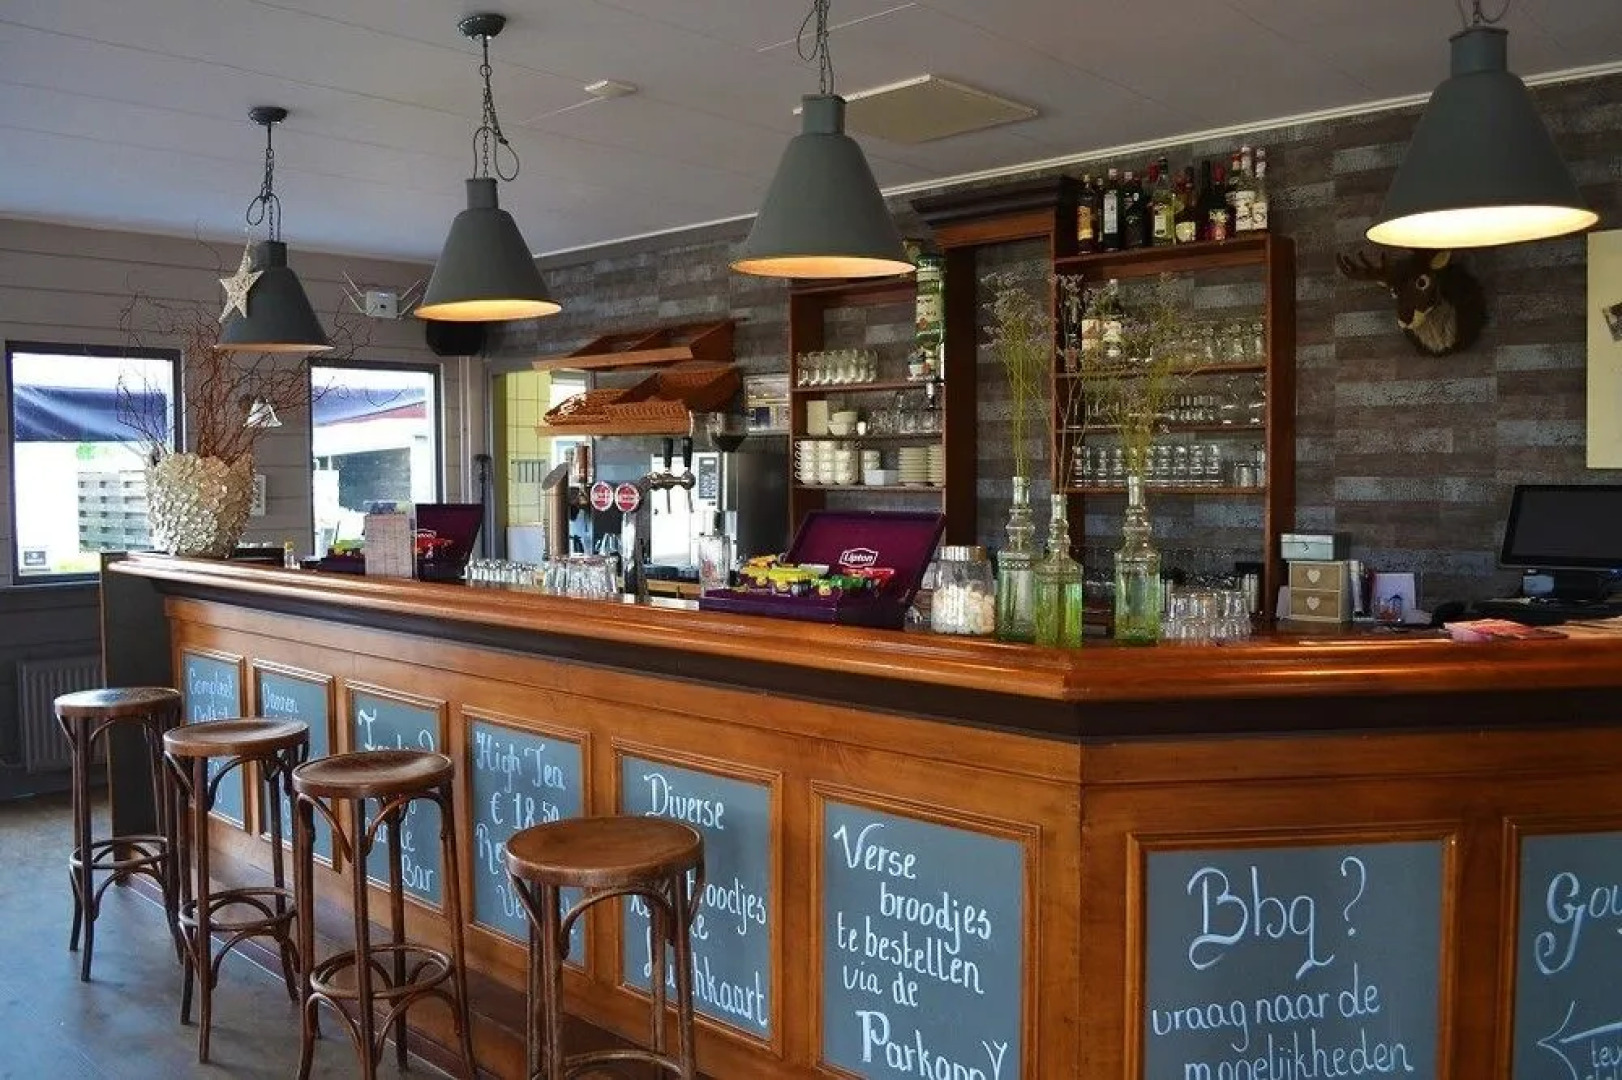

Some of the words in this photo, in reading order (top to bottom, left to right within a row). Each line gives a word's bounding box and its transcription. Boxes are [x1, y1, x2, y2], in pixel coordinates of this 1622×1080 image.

[844, 552, 874, 564] Lipton
[475, 731, 522, 793] High
[523, 743, 567, 791] Tea
[644, 772, 726, 830] Diverse
[401, 854, 435, 893] Bar
[832, 822, 919, 880] Verse
[879, 881, 992, 955] broodjes
[1185, 864, 1335, 979] Bbq
[837, 911, 860, 953] te
[864, 915, 985, 995] bestellen
[842, 961, 883, 995] via
[892, 972, 920, 1007] de
[1151, 999, 1249, 1053] vraag
[1254, 991, 1331, 1026] naar
[1337, 962, 1382, 1019] de
